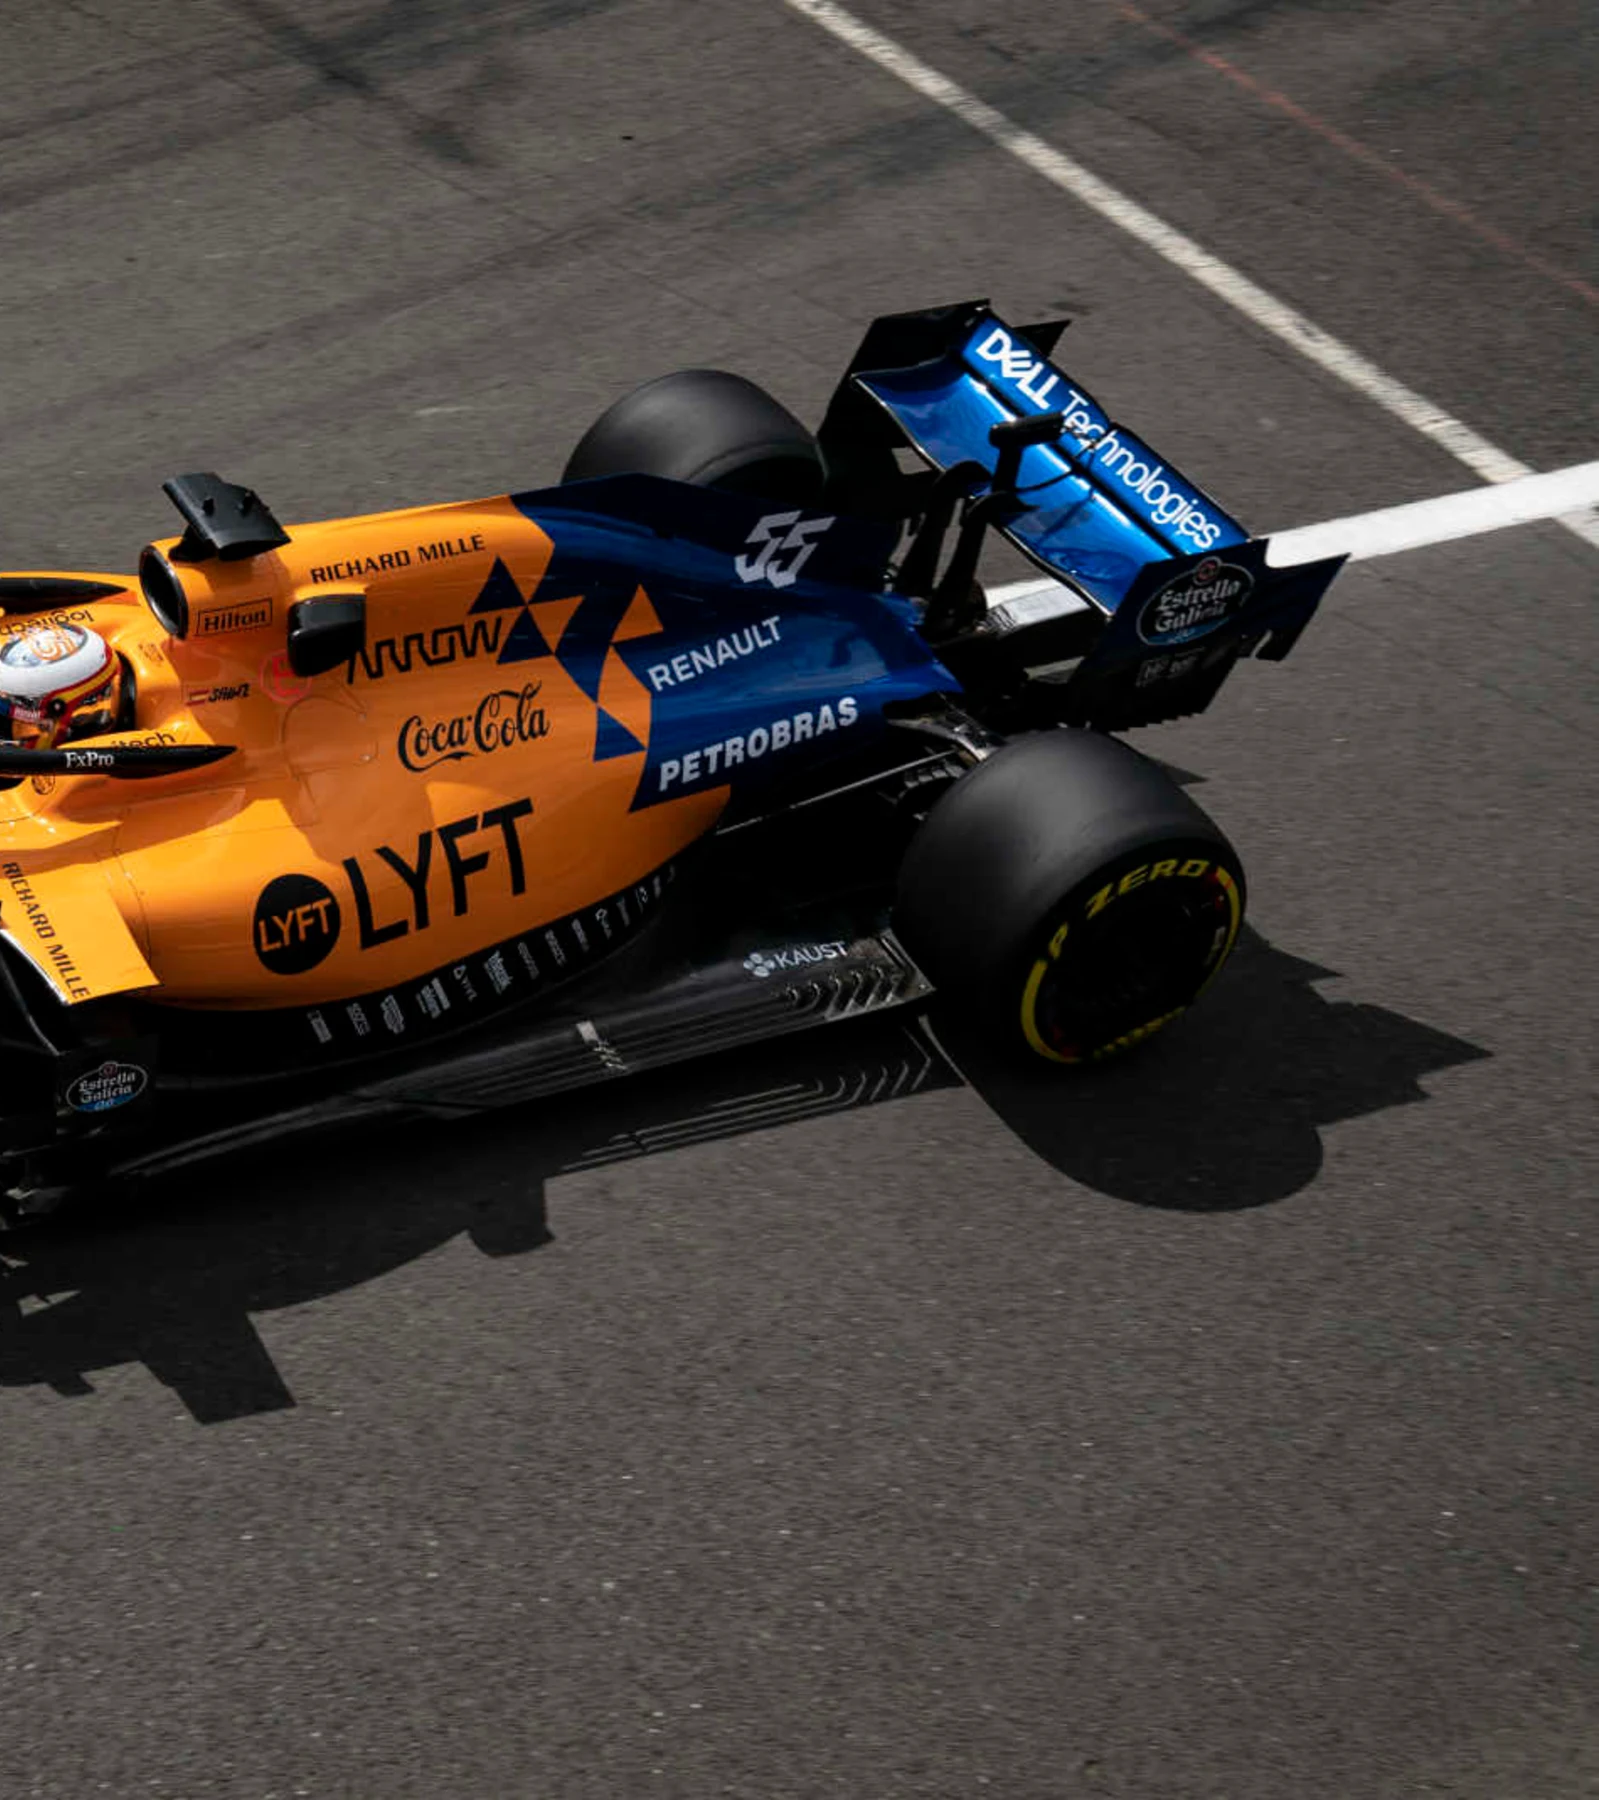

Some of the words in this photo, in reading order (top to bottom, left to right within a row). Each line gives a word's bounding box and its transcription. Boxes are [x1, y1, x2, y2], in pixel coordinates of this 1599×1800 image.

[976, 327, 1060, 410] DELL
[1061, 389, 1221, 549] Technologies
[310, 551, 411, 583] RICHARD
[418, 534, 486, 562] MILLE
[733, 509, 838, 589] 55
[204, 610, 267, 632] Hilton
[647, 614, 782, 692] RENAULT
[65, 751, 115, 769] FxPro
[658, 696, 859, 792] PETROBRAS
[342, 797, 534, 950] LYFT
[1084, 858, 1211, 920] ZERO
[2, 862, 56, 939] RICHARD
[45, 943, 91, 999] MILLE
[259, 897, 331, 952] LYFT
[774, 941, 848, 968] KAUST
